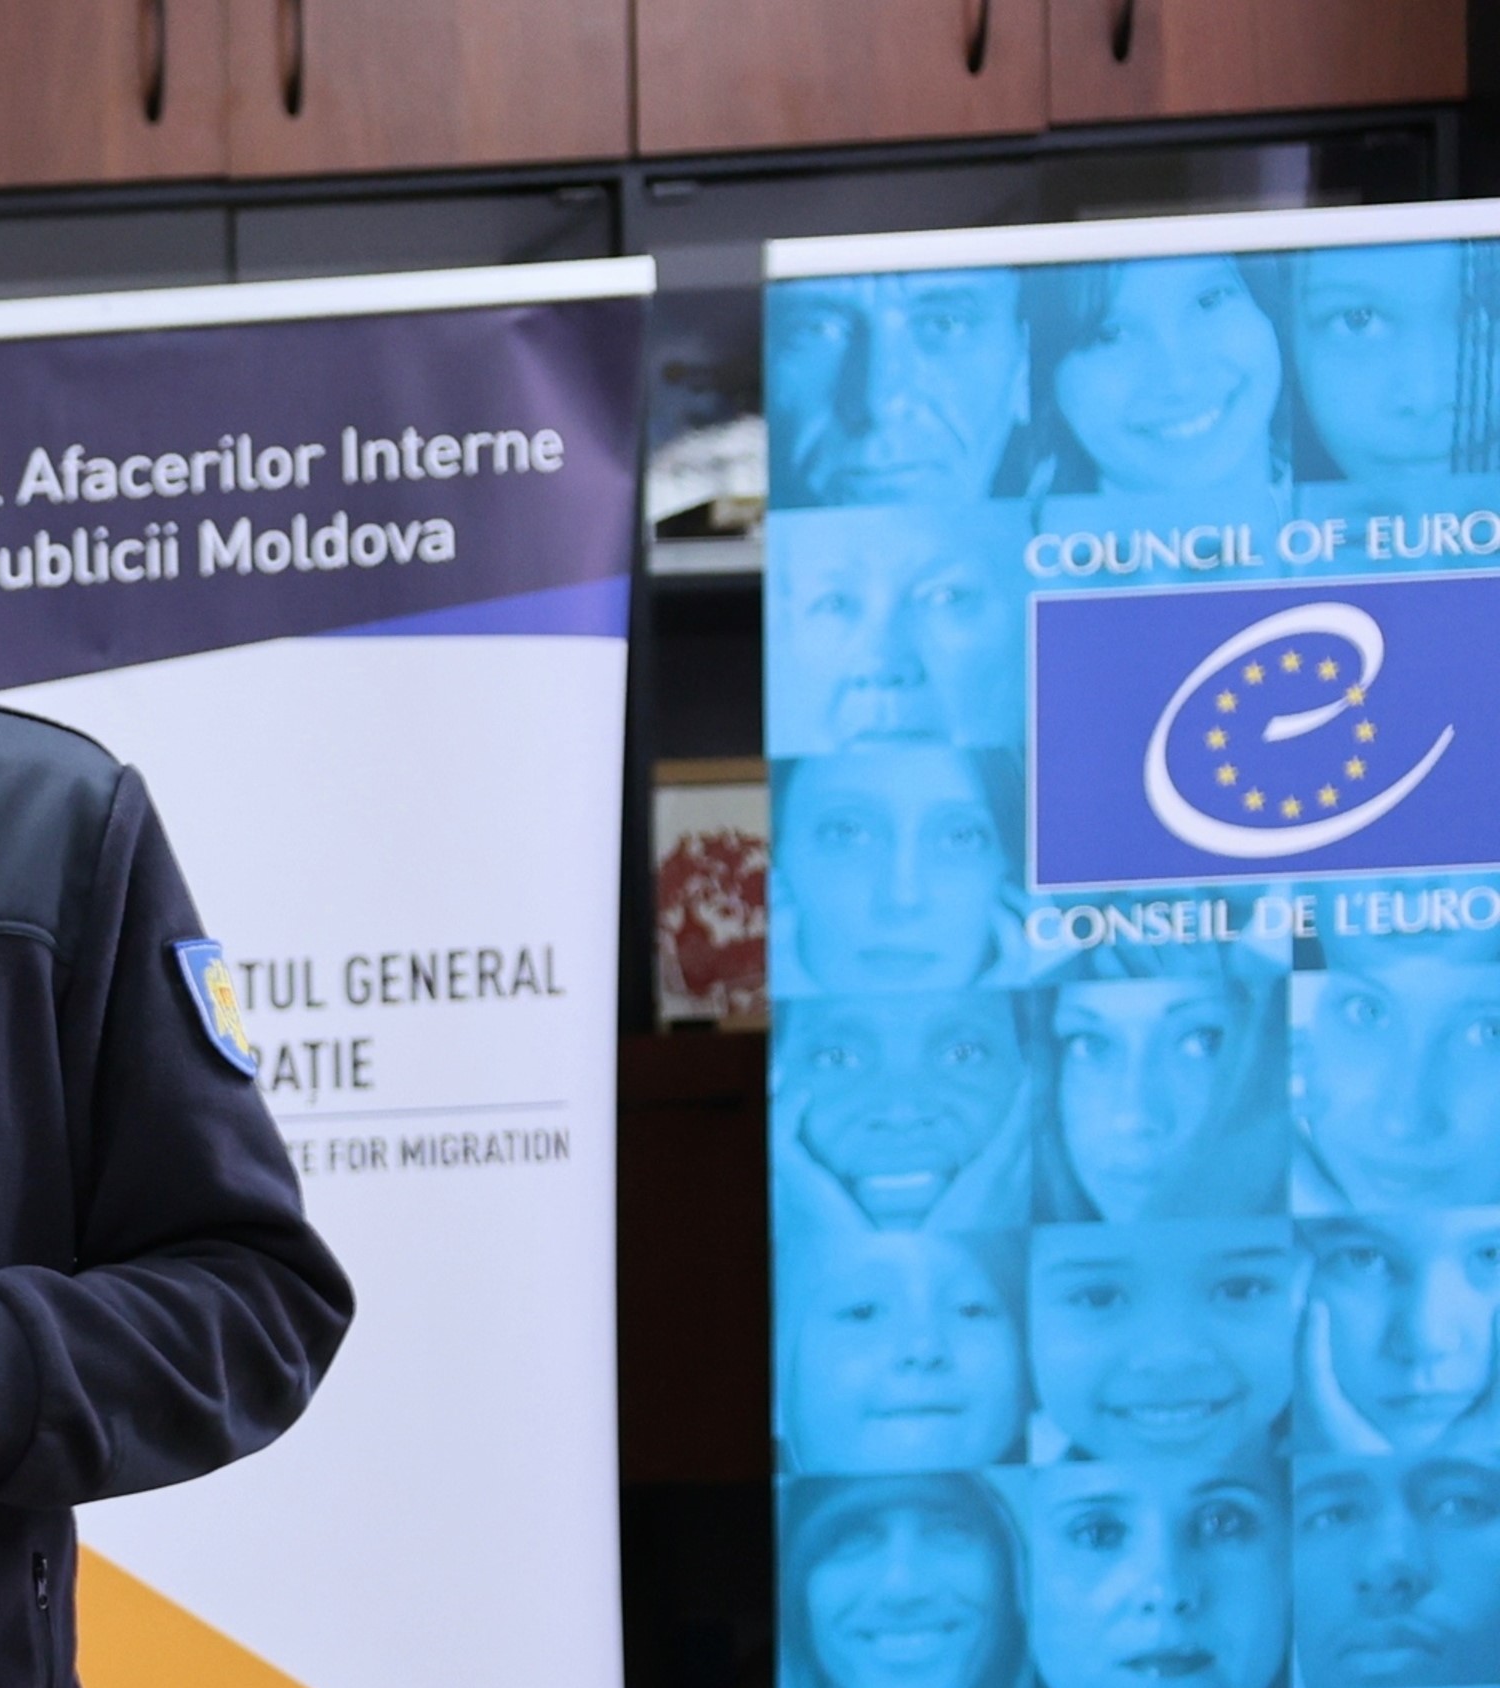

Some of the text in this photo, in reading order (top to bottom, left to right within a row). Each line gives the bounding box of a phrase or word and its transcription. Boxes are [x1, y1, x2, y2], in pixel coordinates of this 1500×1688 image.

[15, 433, 325, 505] Afacerilor
[341, 425, 565, 484] Interne
[198, 510, 457, 578] Moldova
[1024, 523, 1264, 578] COUNCIL
[1278, 517, 1348, 565] OF
[1026, 899, 1240, 951] CONSEIL
[1253, 894, 1318, 940] DE
[343, 943, 567, 1007] GENERAL
[328, 1136, 389, 1174] FOR
[399, 1127, 571, 1169] MIGRATION
